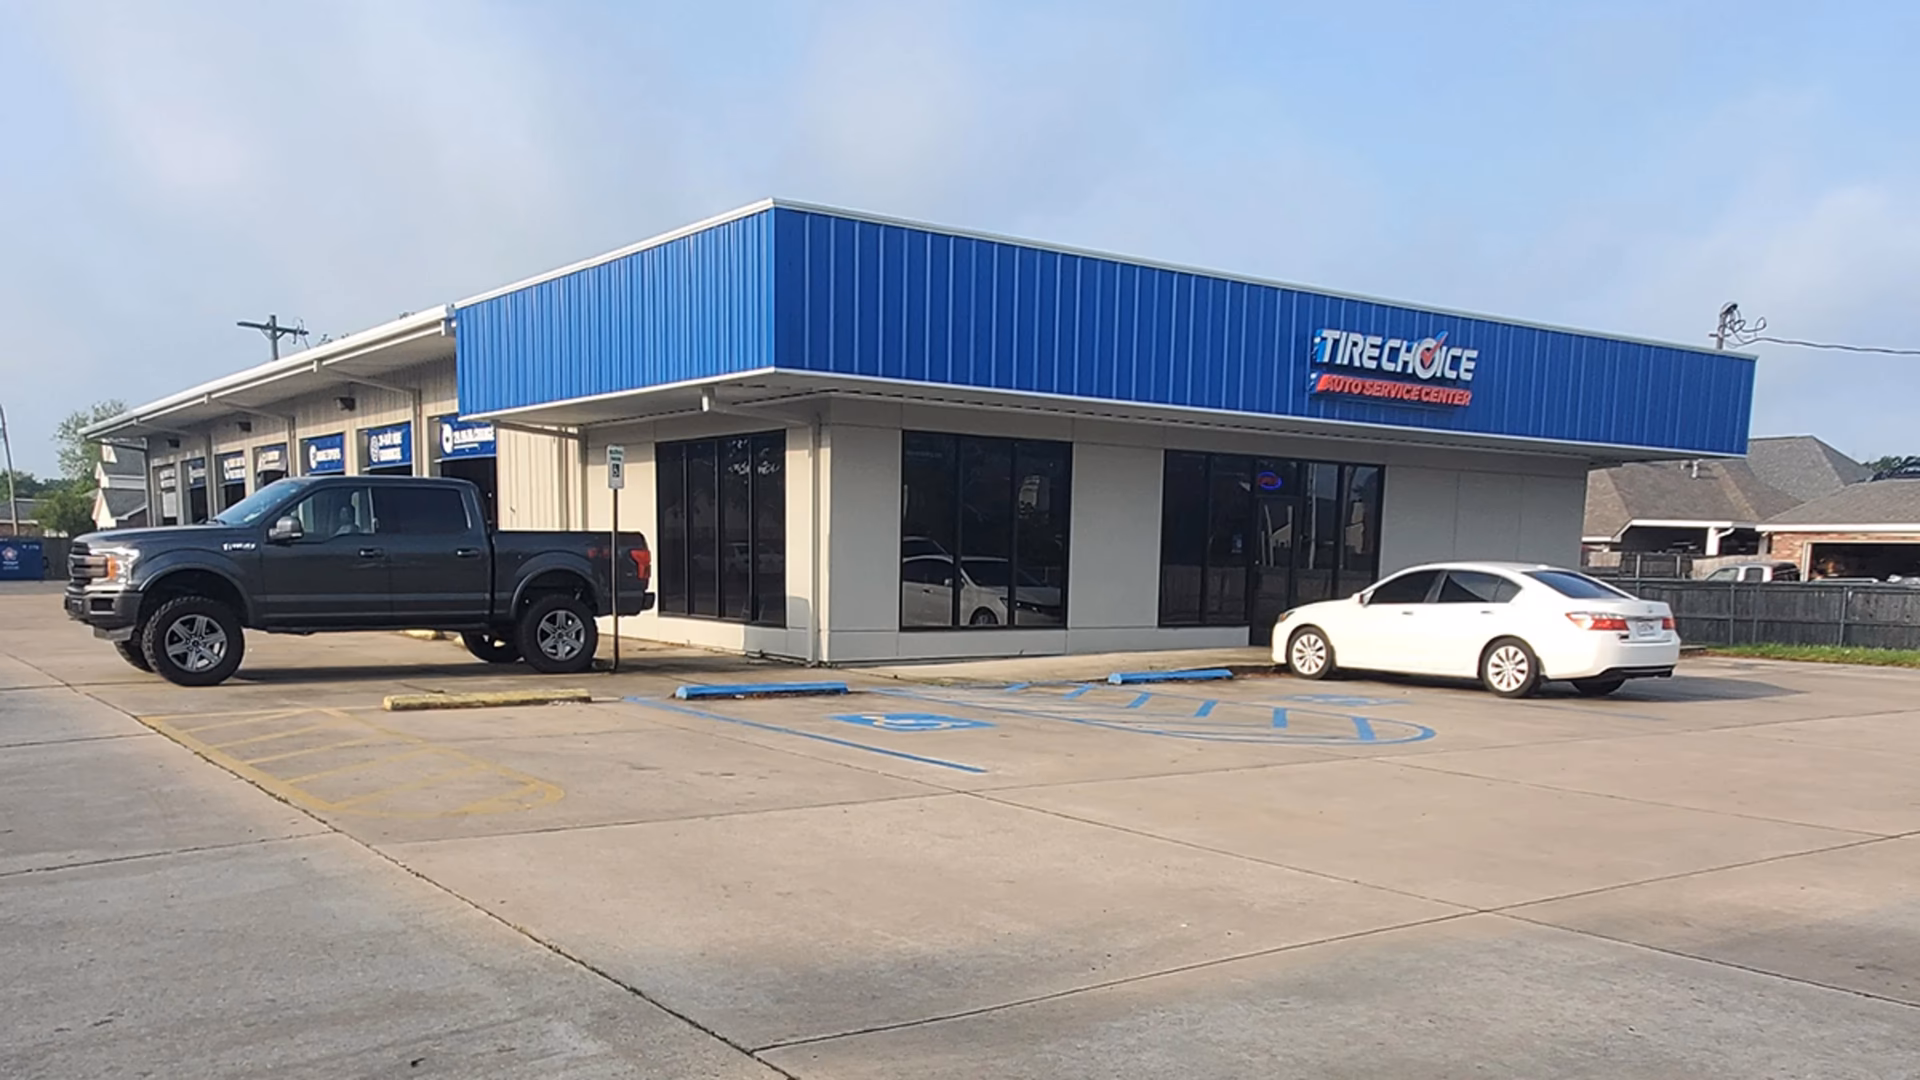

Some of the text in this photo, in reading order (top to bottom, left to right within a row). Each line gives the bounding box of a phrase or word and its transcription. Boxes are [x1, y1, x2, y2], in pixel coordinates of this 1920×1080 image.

[1321, 329, 1479, 381] TIRE CHOICE
[1323, 375, 1473, 406] AUTO SERVICE CENTER
